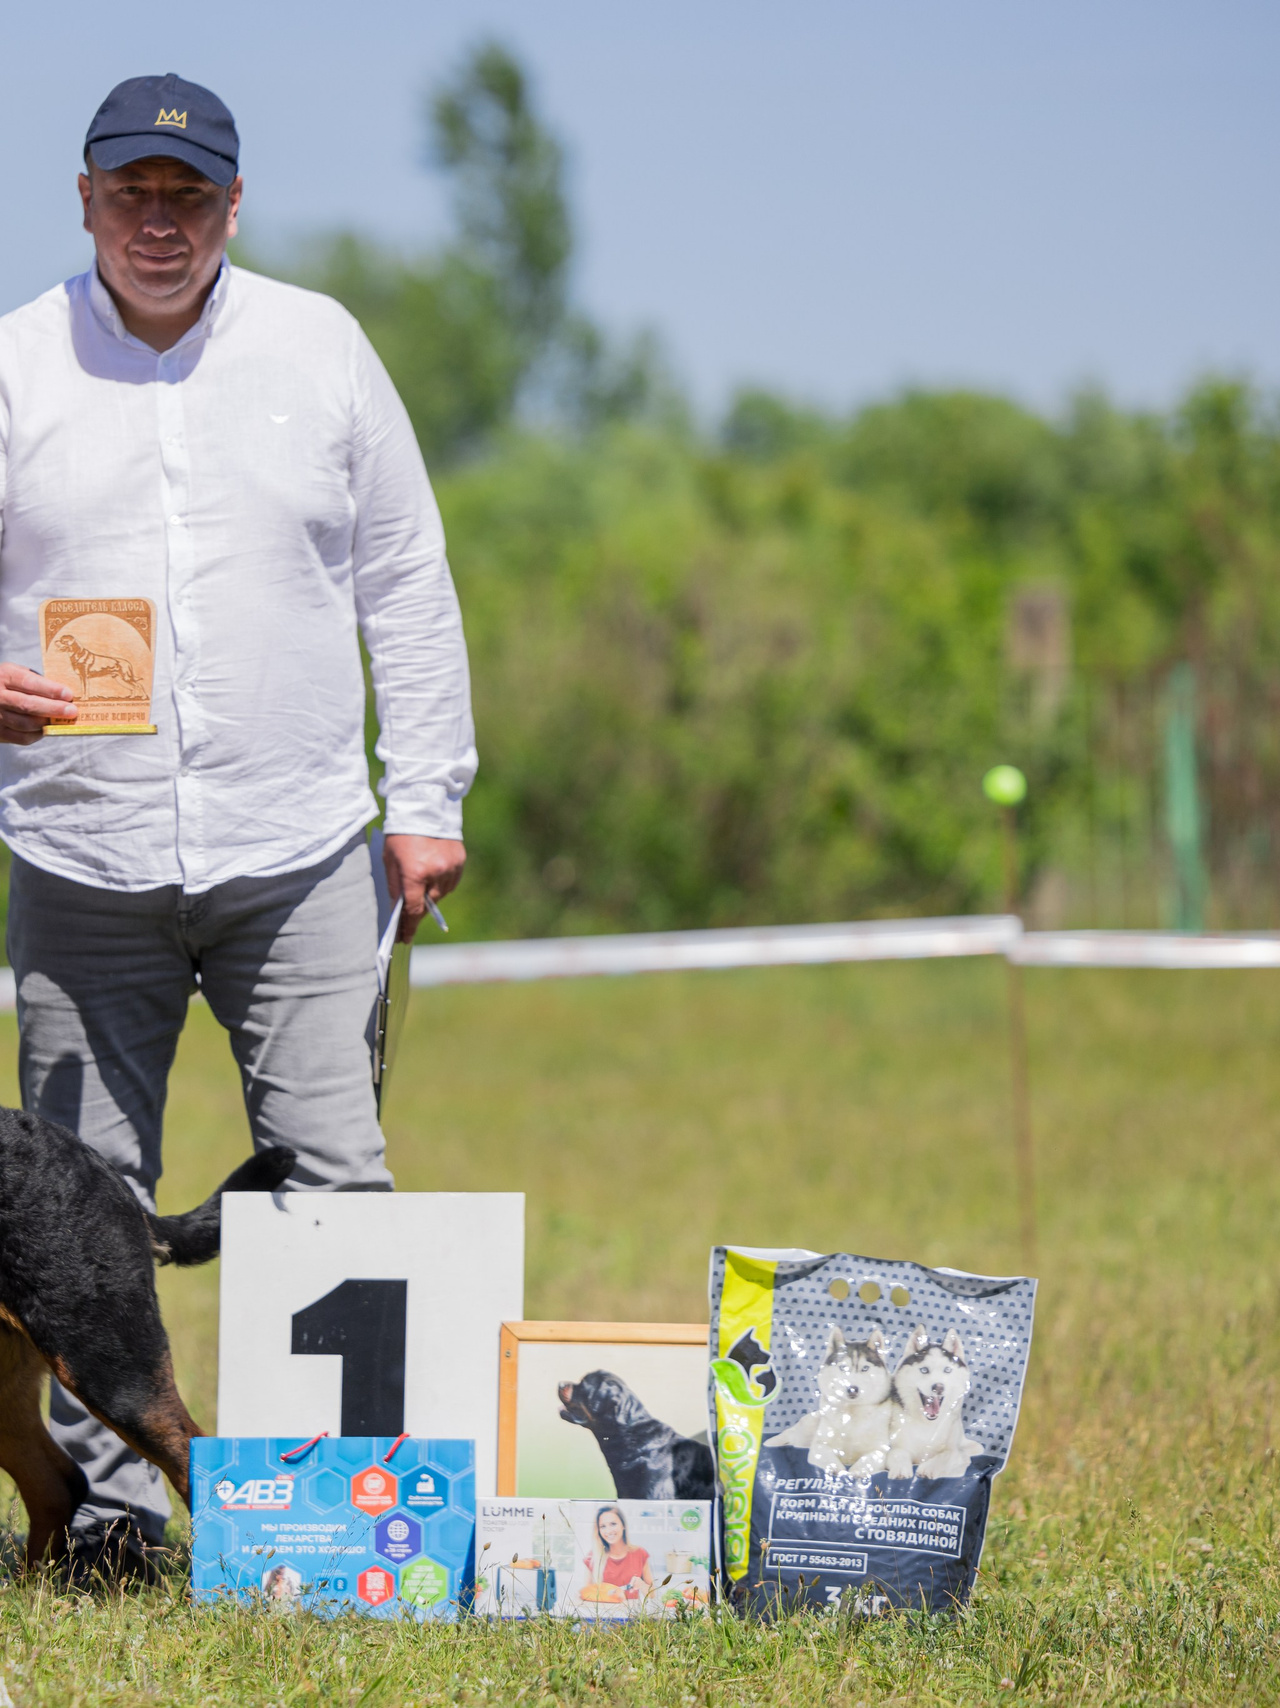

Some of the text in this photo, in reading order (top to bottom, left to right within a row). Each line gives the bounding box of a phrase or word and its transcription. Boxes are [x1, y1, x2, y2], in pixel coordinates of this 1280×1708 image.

[51, 600, 146, 613] ПОБЕДИТЕЛЬ КЛАССА
[291, 1279, 408, 1438] 1
[779, 1498, 816, 1508] КОРМ
[921, 1507, 961, 1522] СОБАК
[261, 1523, 278, 1532] МЫ
[776, 1509, 840, 1523] КРУПНЫХ
[841, 1513, 851, 1523] И
[918, 1520, 959, 1537] ПОРОД
[854, 1527, 958, 1551] С ГОВЯДИНОЙ
[241, 1545, 250, 1553] И
[295, 1545, 316, 1553] ЭТО
[772, 1553, 863, 1568] ГОСТ Р 55453-2013
